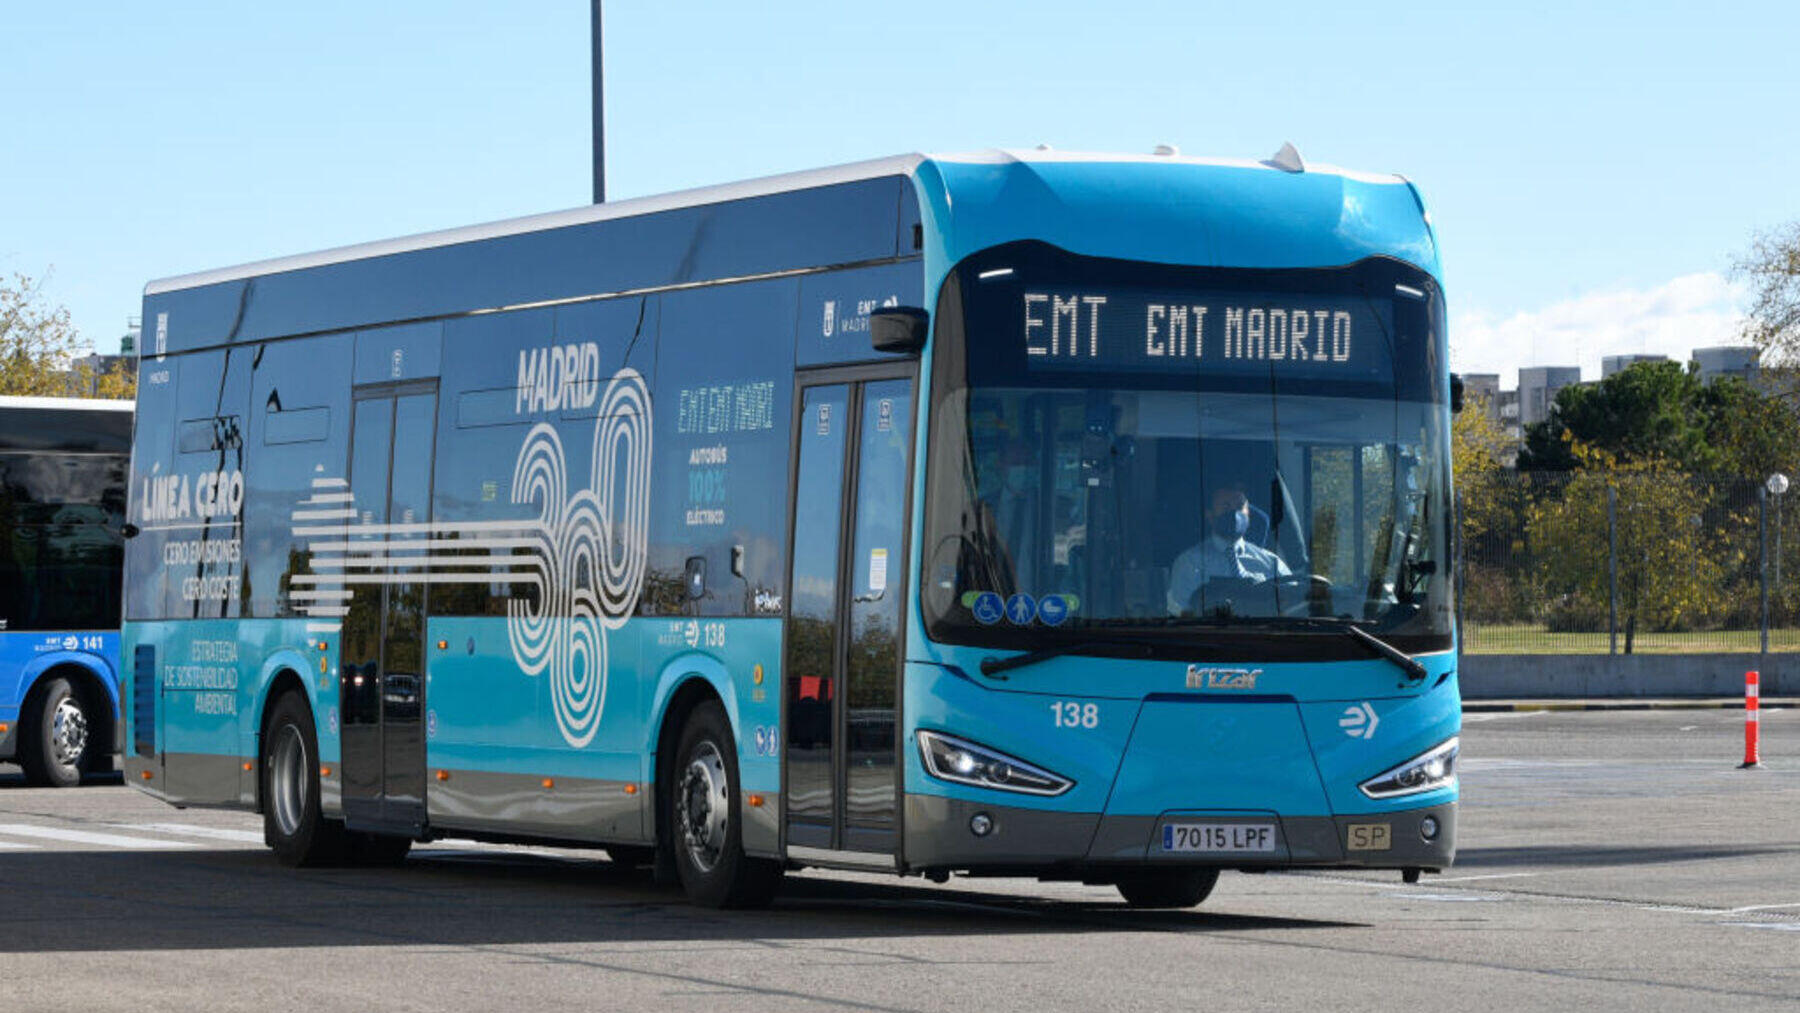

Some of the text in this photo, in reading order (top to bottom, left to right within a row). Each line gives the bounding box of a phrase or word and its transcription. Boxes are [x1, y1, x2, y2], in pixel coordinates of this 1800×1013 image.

[1024, 293, 1107, 356] EMT
[1147, 305, 1350, 361] EMT MADRID
[515, 341, 599, 415] MADRID
[142, 461, 243, 520] LÍNEA CERO
[164, 542, 188, 565] CERO
[182, 577, 207, 600] CERO
[83, 636, 103, 650] 141
[705, 622, 725, 647] 138
[1050, 701, 1099, 728] 138
[1177, 827, 1226, 849] 7015
[1233, 827, 1269, 849] LPF
[1354, 827, 1386, 848] SP
